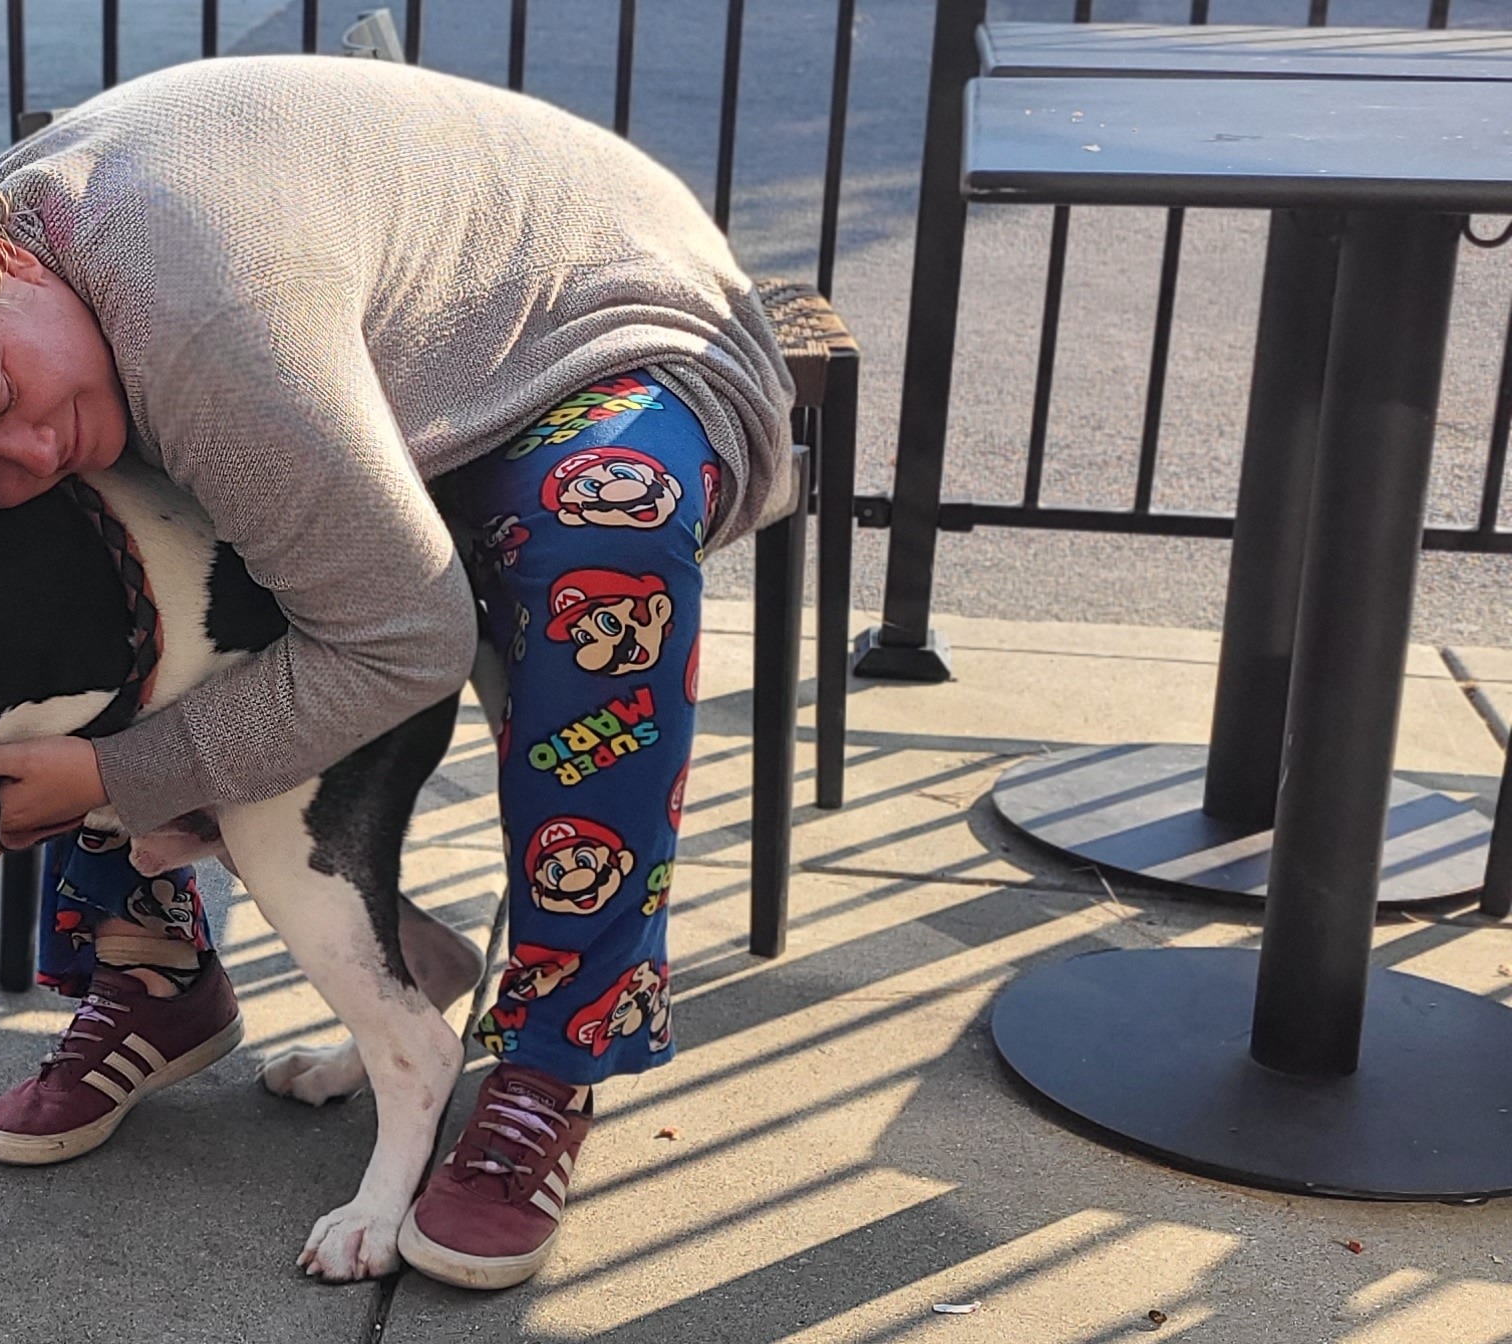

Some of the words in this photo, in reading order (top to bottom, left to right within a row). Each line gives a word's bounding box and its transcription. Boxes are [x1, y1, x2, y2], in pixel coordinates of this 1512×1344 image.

[544, 394, 664, 444] SUPER
[528, 686, 655, 771] MARIO
[554, 721, 660, 786] SUPER
